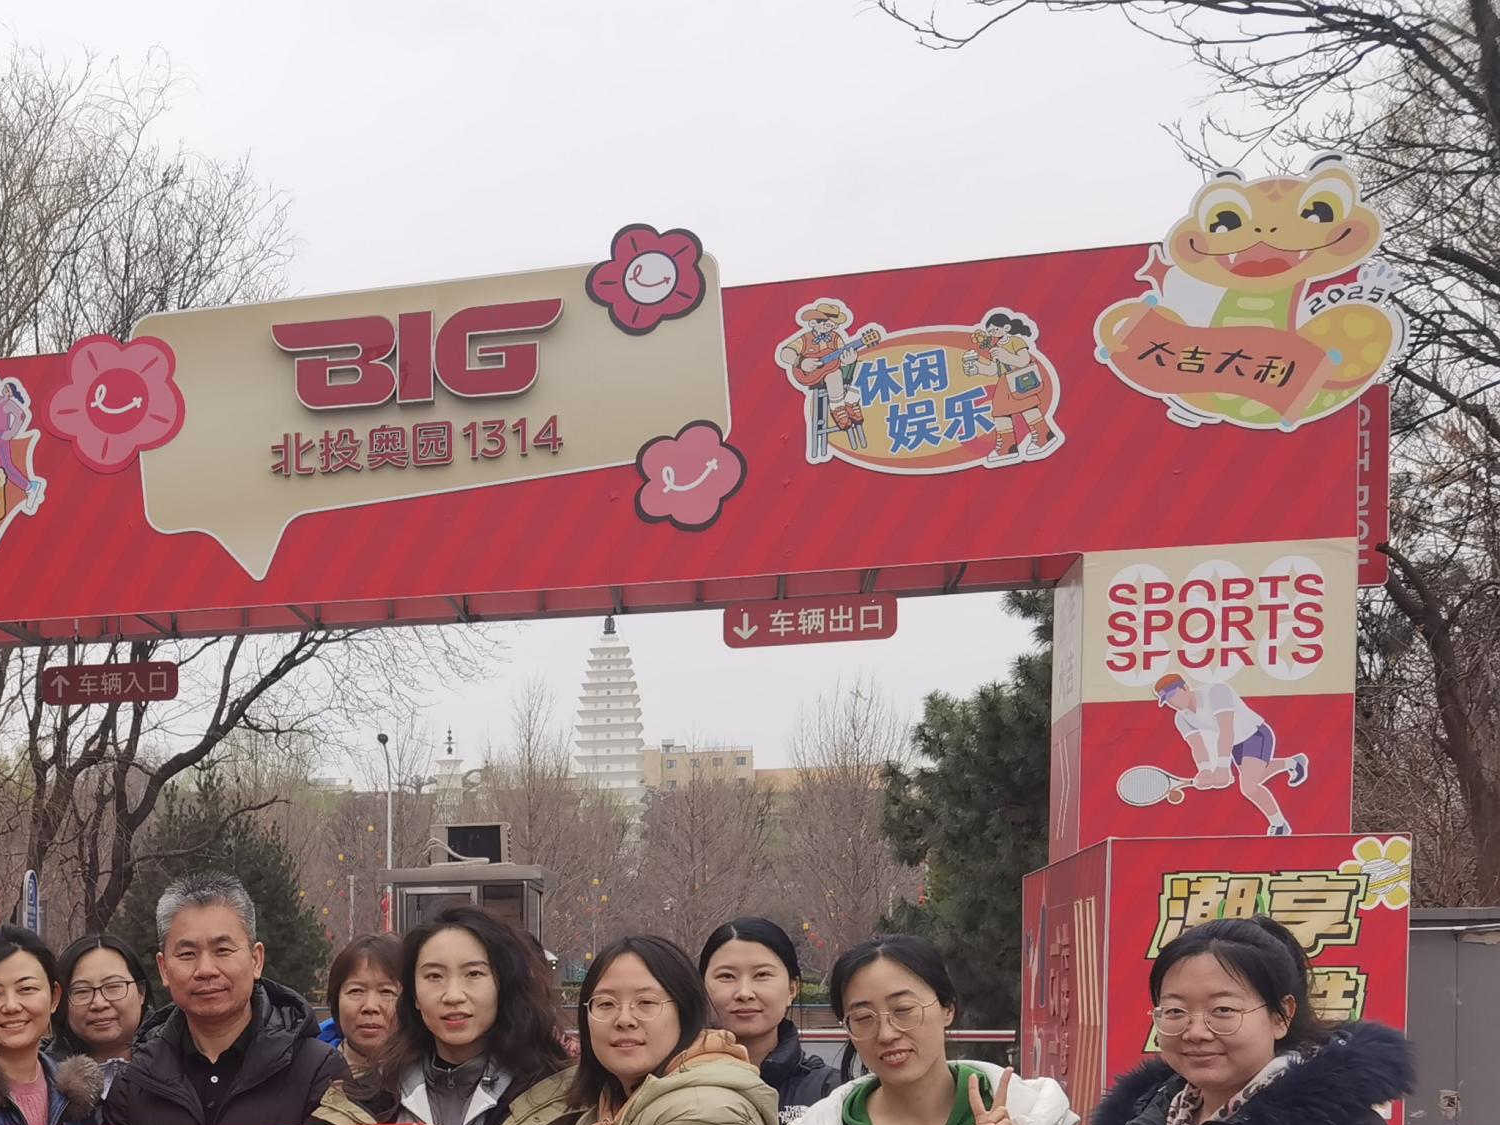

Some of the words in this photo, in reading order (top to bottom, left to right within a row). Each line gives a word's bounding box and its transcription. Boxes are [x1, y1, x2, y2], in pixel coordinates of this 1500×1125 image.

[1308, 285, 1386, 315] 2025
[270, 298, 563, 410] BIG
[1137, 341, 1296, 388] 大吉大利
[854, 349, 948, 407] 休闲
[886, 387, 995, 453] 娱乐
[768, 603, 884, 637] 车辆出口
[1106, 602, 1324, 647] SPORTS
[78, 672, 167, 695] 车辆入口
